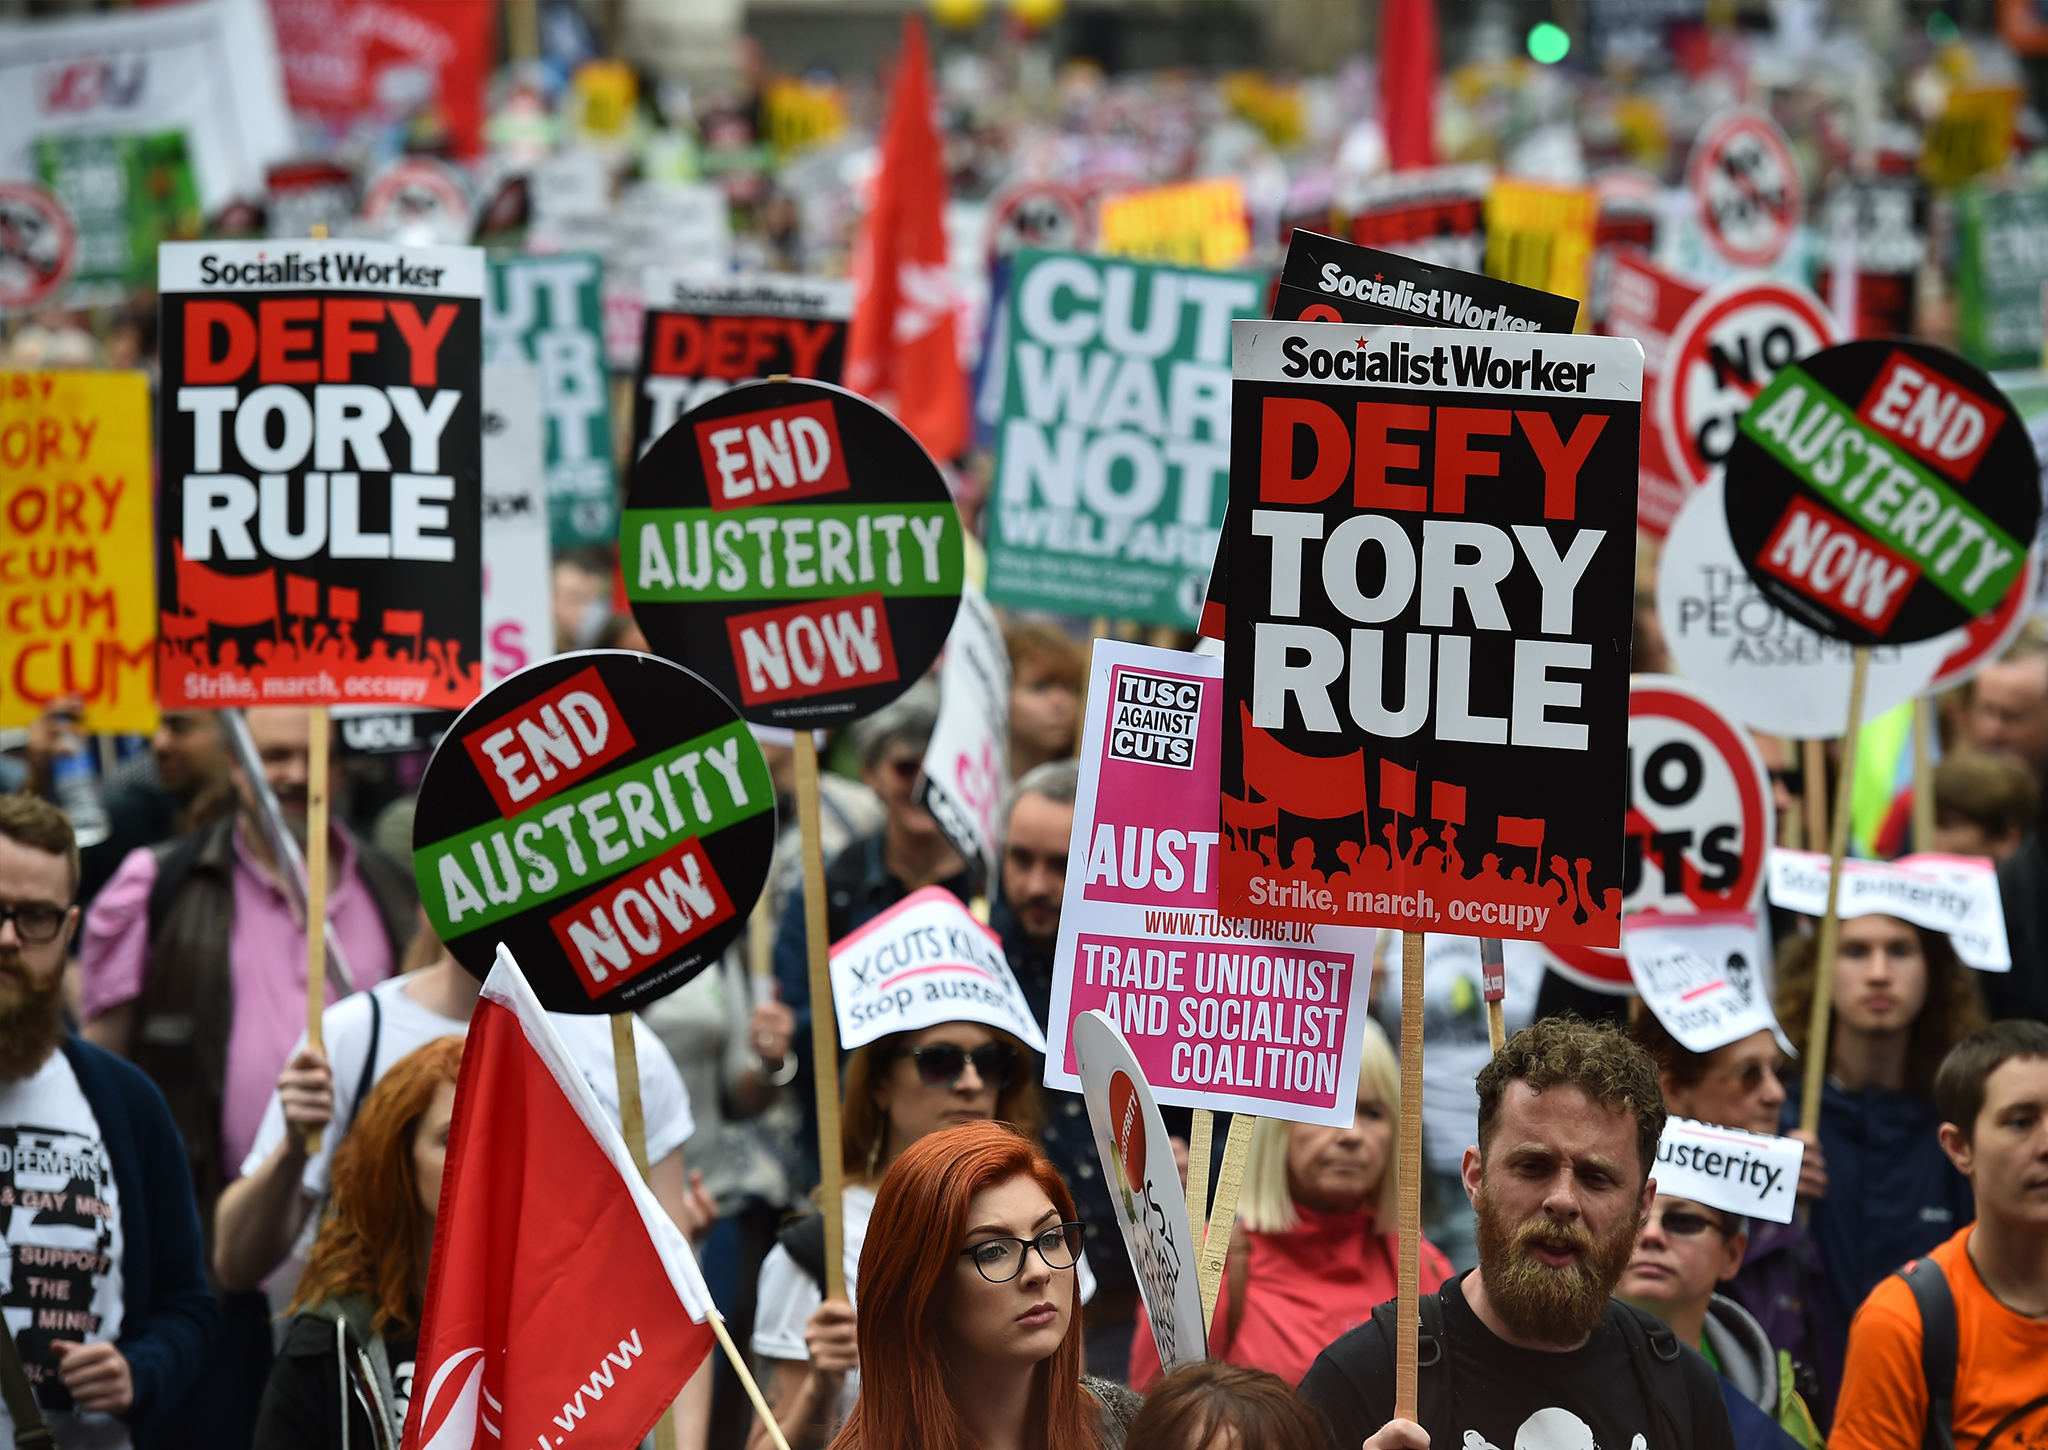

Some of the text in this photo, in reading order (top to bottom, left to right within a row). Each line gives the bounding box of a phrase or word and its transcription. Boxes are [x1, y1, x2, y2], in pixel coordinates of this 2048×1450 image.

[201, 251, 446, 288] Socialist Worker
[1318, 262, 1542, 333] Socialist Worker
[183, 297, 462, 388] DEFY
[1019, 256, 1258, 363] CUT
[653, 313, 837, 381] DEFY
[1281, 335, 1596, 394] Socialist Worker
[1708, 325, 1798, 390] NO
[177, 384, 463, 474] TORY
[1014, 341, 1233, 447] WAR
[1870, 364, 1986, 462] END
[709, 415, 831, 499] END
[1001, 416, 1231, 527] NOT
[1259, 396, 1611, 520] DEFY
[1754, 382, 2014, 598] AUSTERITY
[182, 471, 456, 562] RULE
[638, 514, 945, 592] AUSTERITY
[1251, 509, 1608, 635] TORY
[1770, 509, 1909, 620] NOW
[739, 606, 883, 693] NOW
[1252, 622, 1593, 751] RULE
[184, 673, 431, 701] Strike, march, occupy
[1117, 705, 1194, 737] AGAINST
[1121, 676, 1198, 710] TUSC
[481, 690, 610, 803] END
[1114, 730, 1190, 764] CUTS
[438, 737, 750, 923] AUSTERITY
[567, 852, 717, 983] NOW
[1145, 910, 1316, 945] WWW.TUSC.ORG.UK
[1249, 876, 1550, 933] Strike, march, occupy
[875, 926, 943, 975] CUTS
[1082, 943, 1347, 1004] TRADE UNIONIST
[850, 987, 914, 1030] Stop
[1104, 991, 1343, 1049] AND SOCIALIST
[1171, 1042, 1339, 1096] COALITION
[22, 1188, 69, 1213] GAY
[26, 1276, 73, 1301] THE
